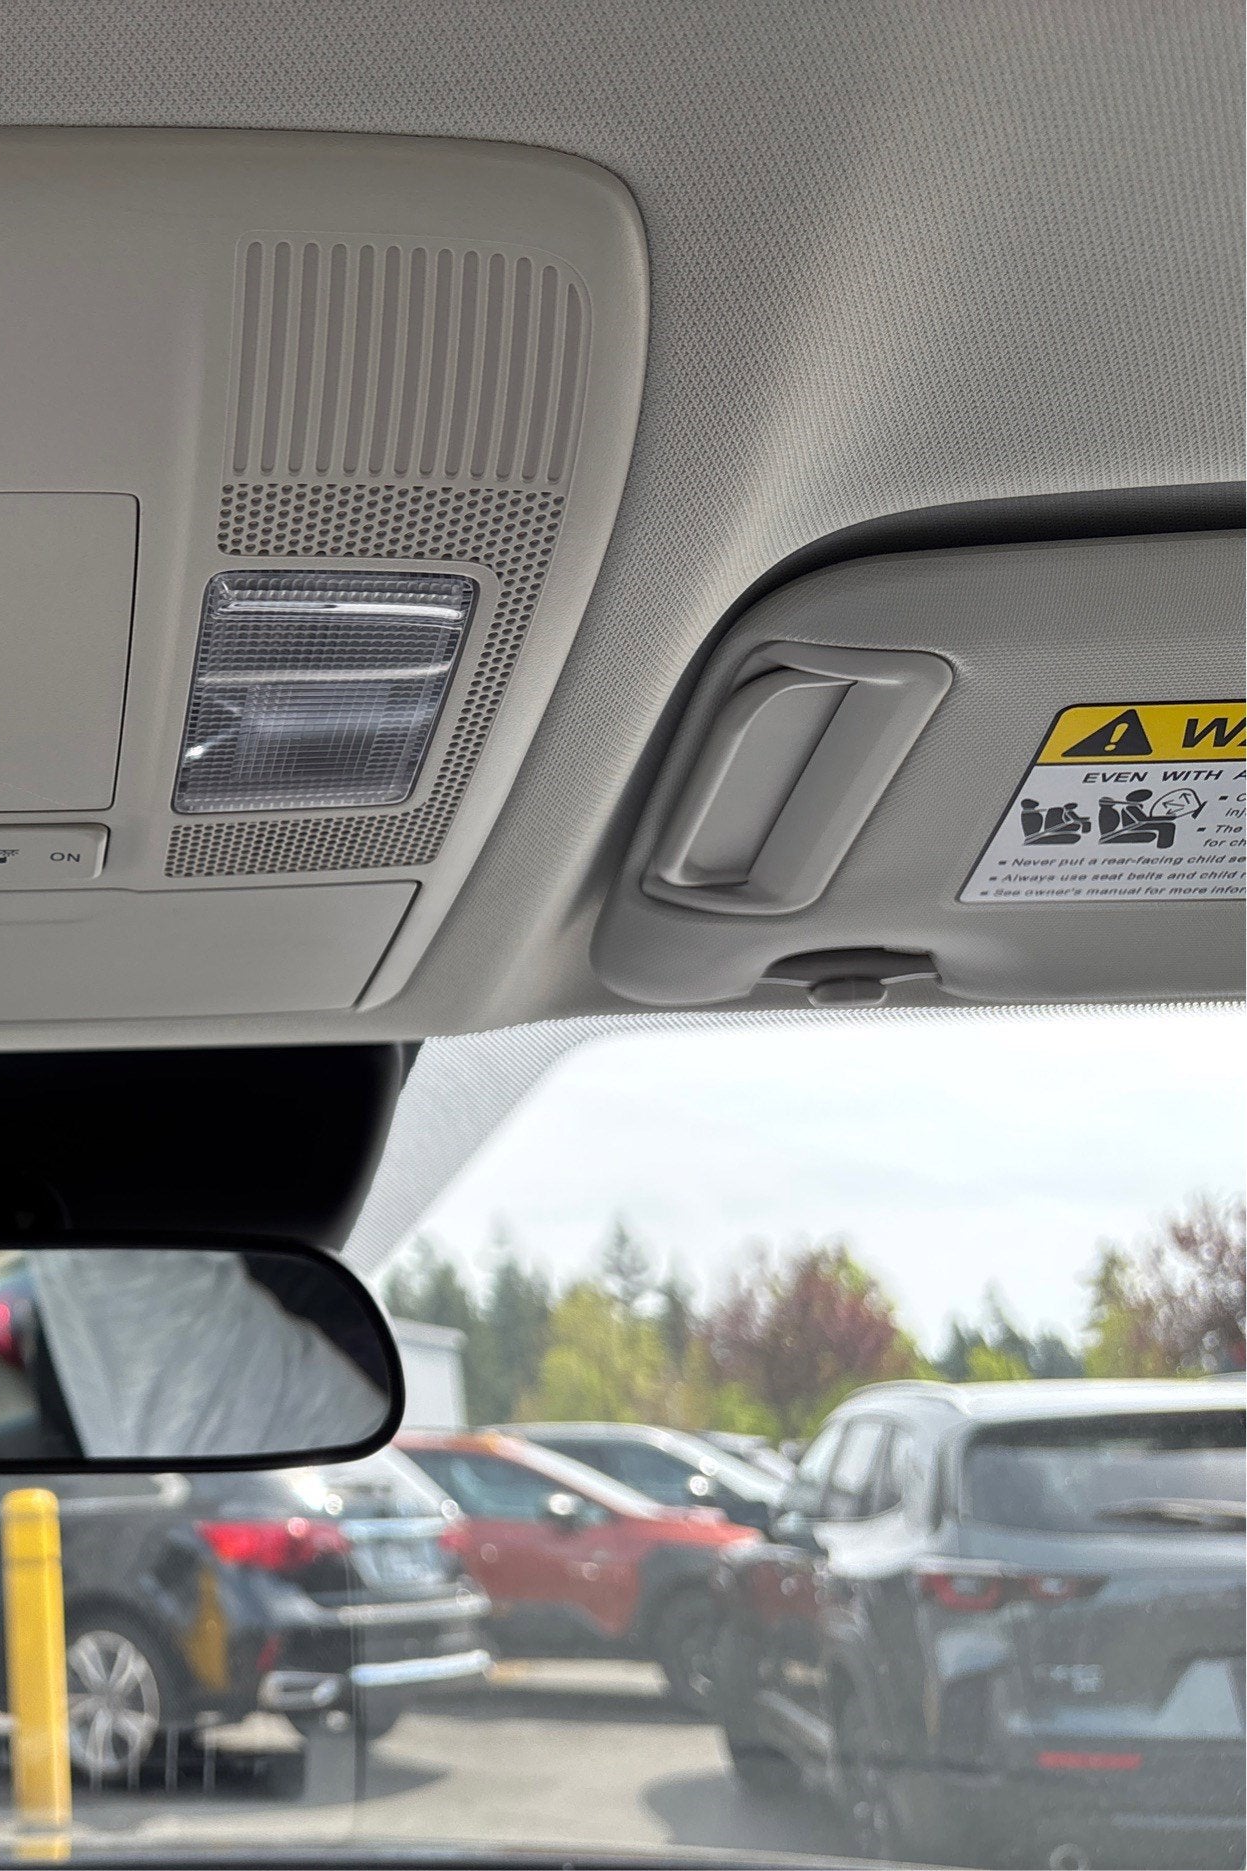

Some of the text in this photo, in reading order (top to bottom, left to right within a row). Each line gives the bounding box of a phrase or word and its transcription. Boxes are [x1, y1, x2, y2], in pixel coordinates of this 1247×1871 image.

[1182, 717, 1246, 748] W
[1082, 771, 1148, 784] EVEN
[1161, 769, 1223, 782] WITH
[1225, 808, 1246, 818] inj
[1216, 824, 1243, 833] The
[1203, 839, 1226, 847] for
[49, 852, 81, 863] ON
[1012, 857, 1056, 867] Never
[1058, 857, 1085, 868] put
[1089, 858, 1097, 866] a
[1101, 856, 1183, 866] rear-facing
[1187, 855, 1226, 864] child
[1002, 873, 1054, 882] Always
[1060, 874, 1088, 882] use
[1091, 873, 1123, 882] seat
[1127, 872, 1163, 881] belts
[1167, 871, 1197, 880] and
[1199, 870, 1238, 880] child
[993, 885, 1246, 897] See owner's manual for more infor
